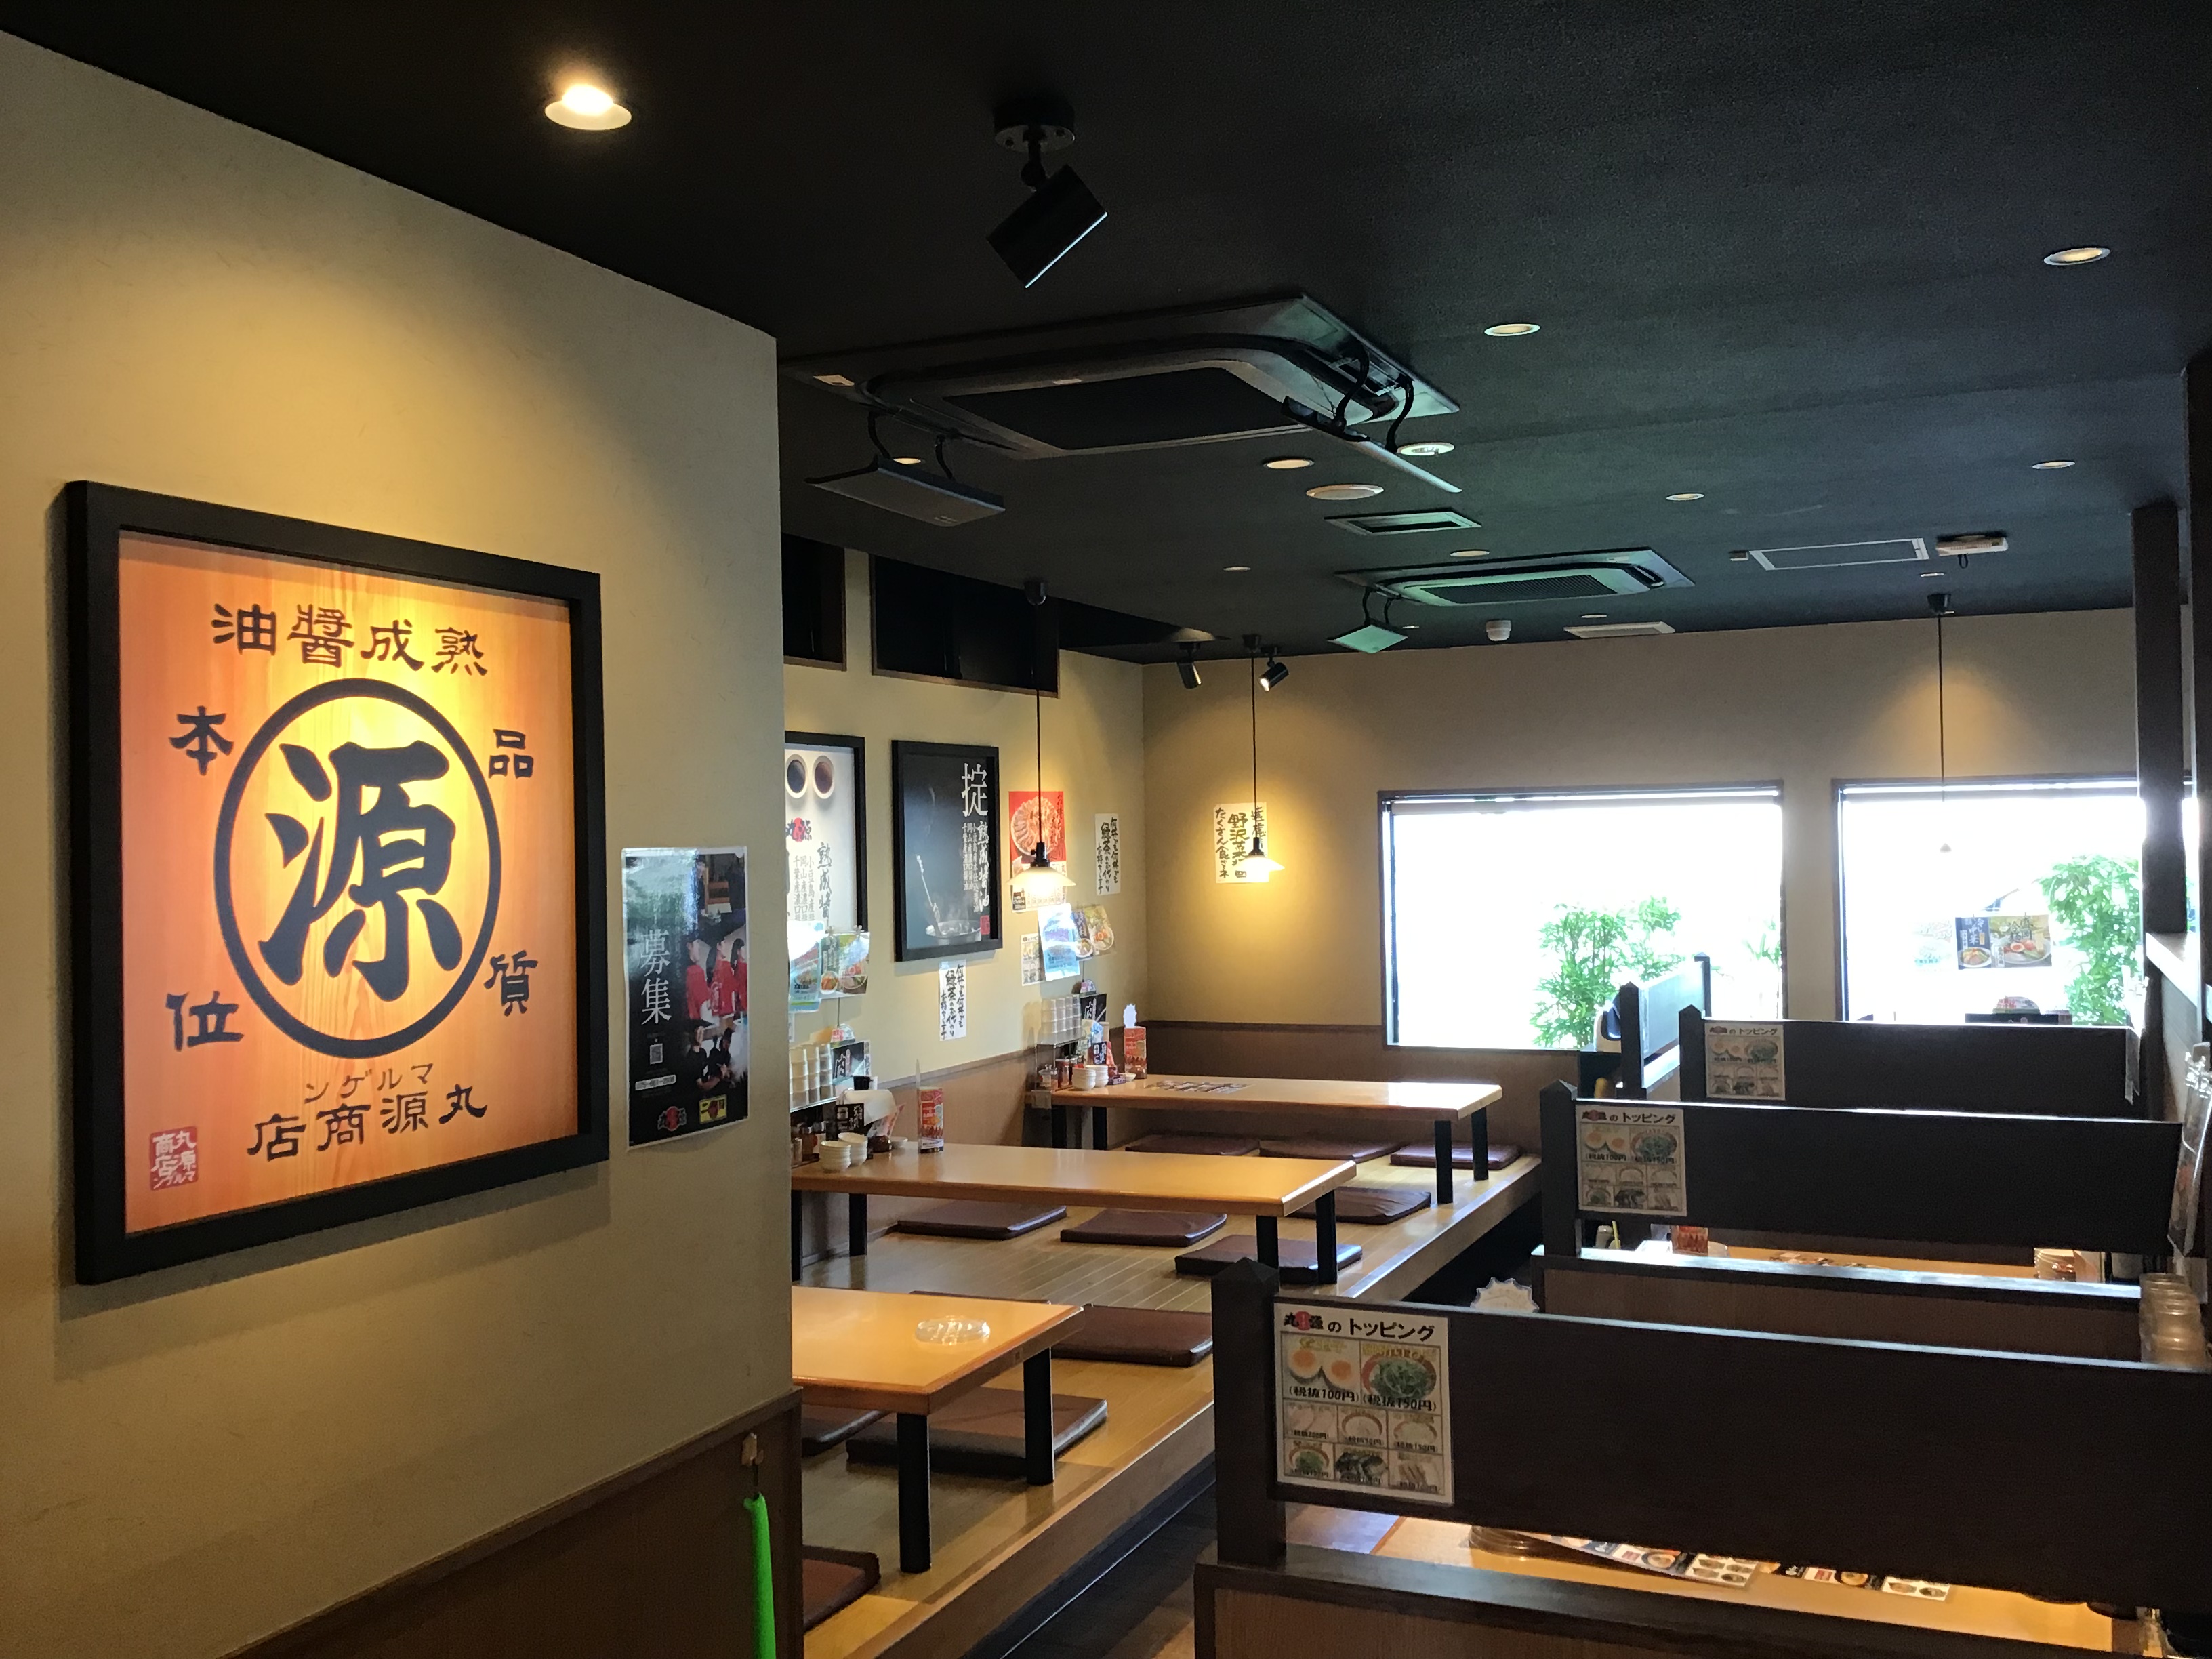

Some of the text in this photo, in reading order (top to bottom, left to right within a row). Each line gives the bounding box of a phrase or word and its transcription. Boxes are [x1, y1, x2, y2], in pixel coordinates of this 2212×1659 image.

[961, 762, 988, 817] 掟
[258, 741, 464, 1002] 源
[817, 841, 832, 927] 熟成醤
[641, 929, 672, 1025] 募集
